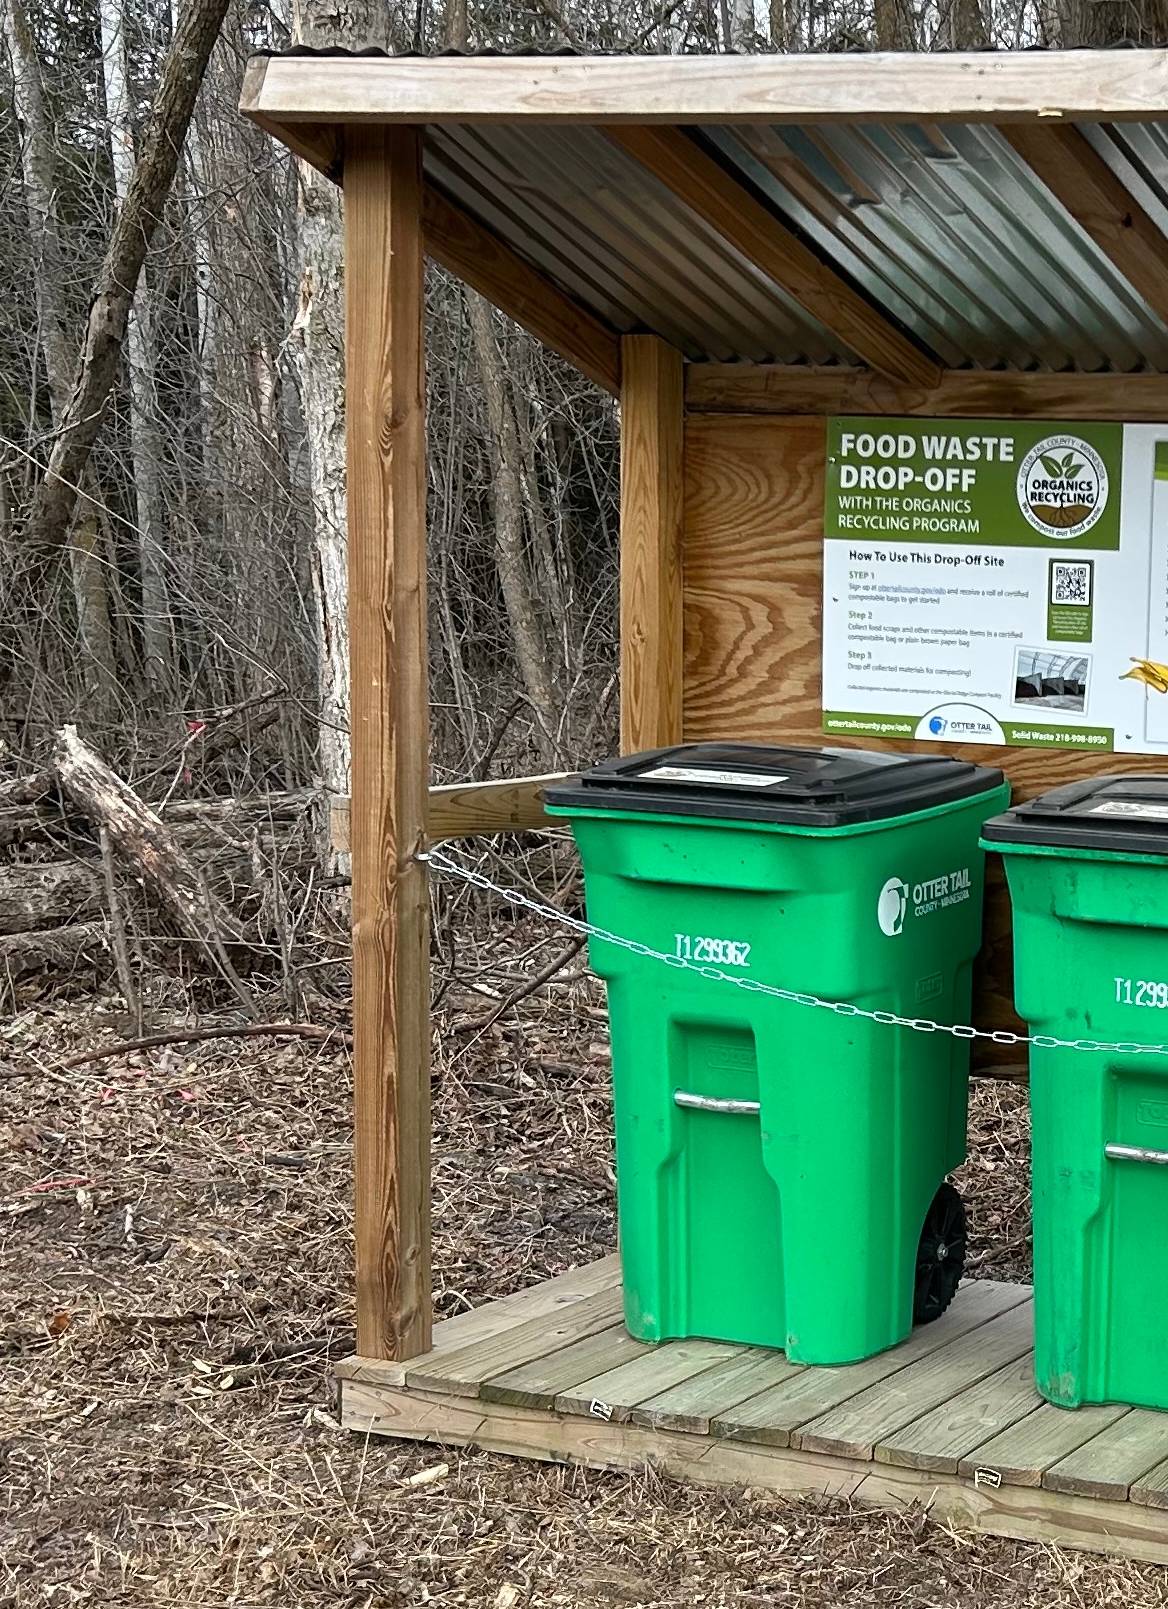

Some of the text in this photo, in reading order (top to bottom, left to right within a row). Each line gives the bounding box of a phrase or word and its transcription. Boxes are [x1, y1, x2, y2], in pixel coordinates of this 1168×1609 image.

[840, 434, 1014, 462] FOOD WASTE
[840, 465, 976, 492] DROP-OFF
[1032, 480, 1092, 492] ORGANICS
[1030, 492, 1094, 504] RECYCLING
[838, 496, 971, 514] WITH THE ORGANICS
[838, 514, 980, 533] RECYCLING PROGRAM
[849, 550, 1005, 567] How To Use This Drop-Off Site
[848, 571, 869, 579] STEP
[848, 610, 866, 621] Step
[848, 650, 866, 661] Step
[950, 721, 976, 730] OTTER
[1032, 732, 1054, 741] Waste
[912, 868, 972, 904] OTTER TAIL
